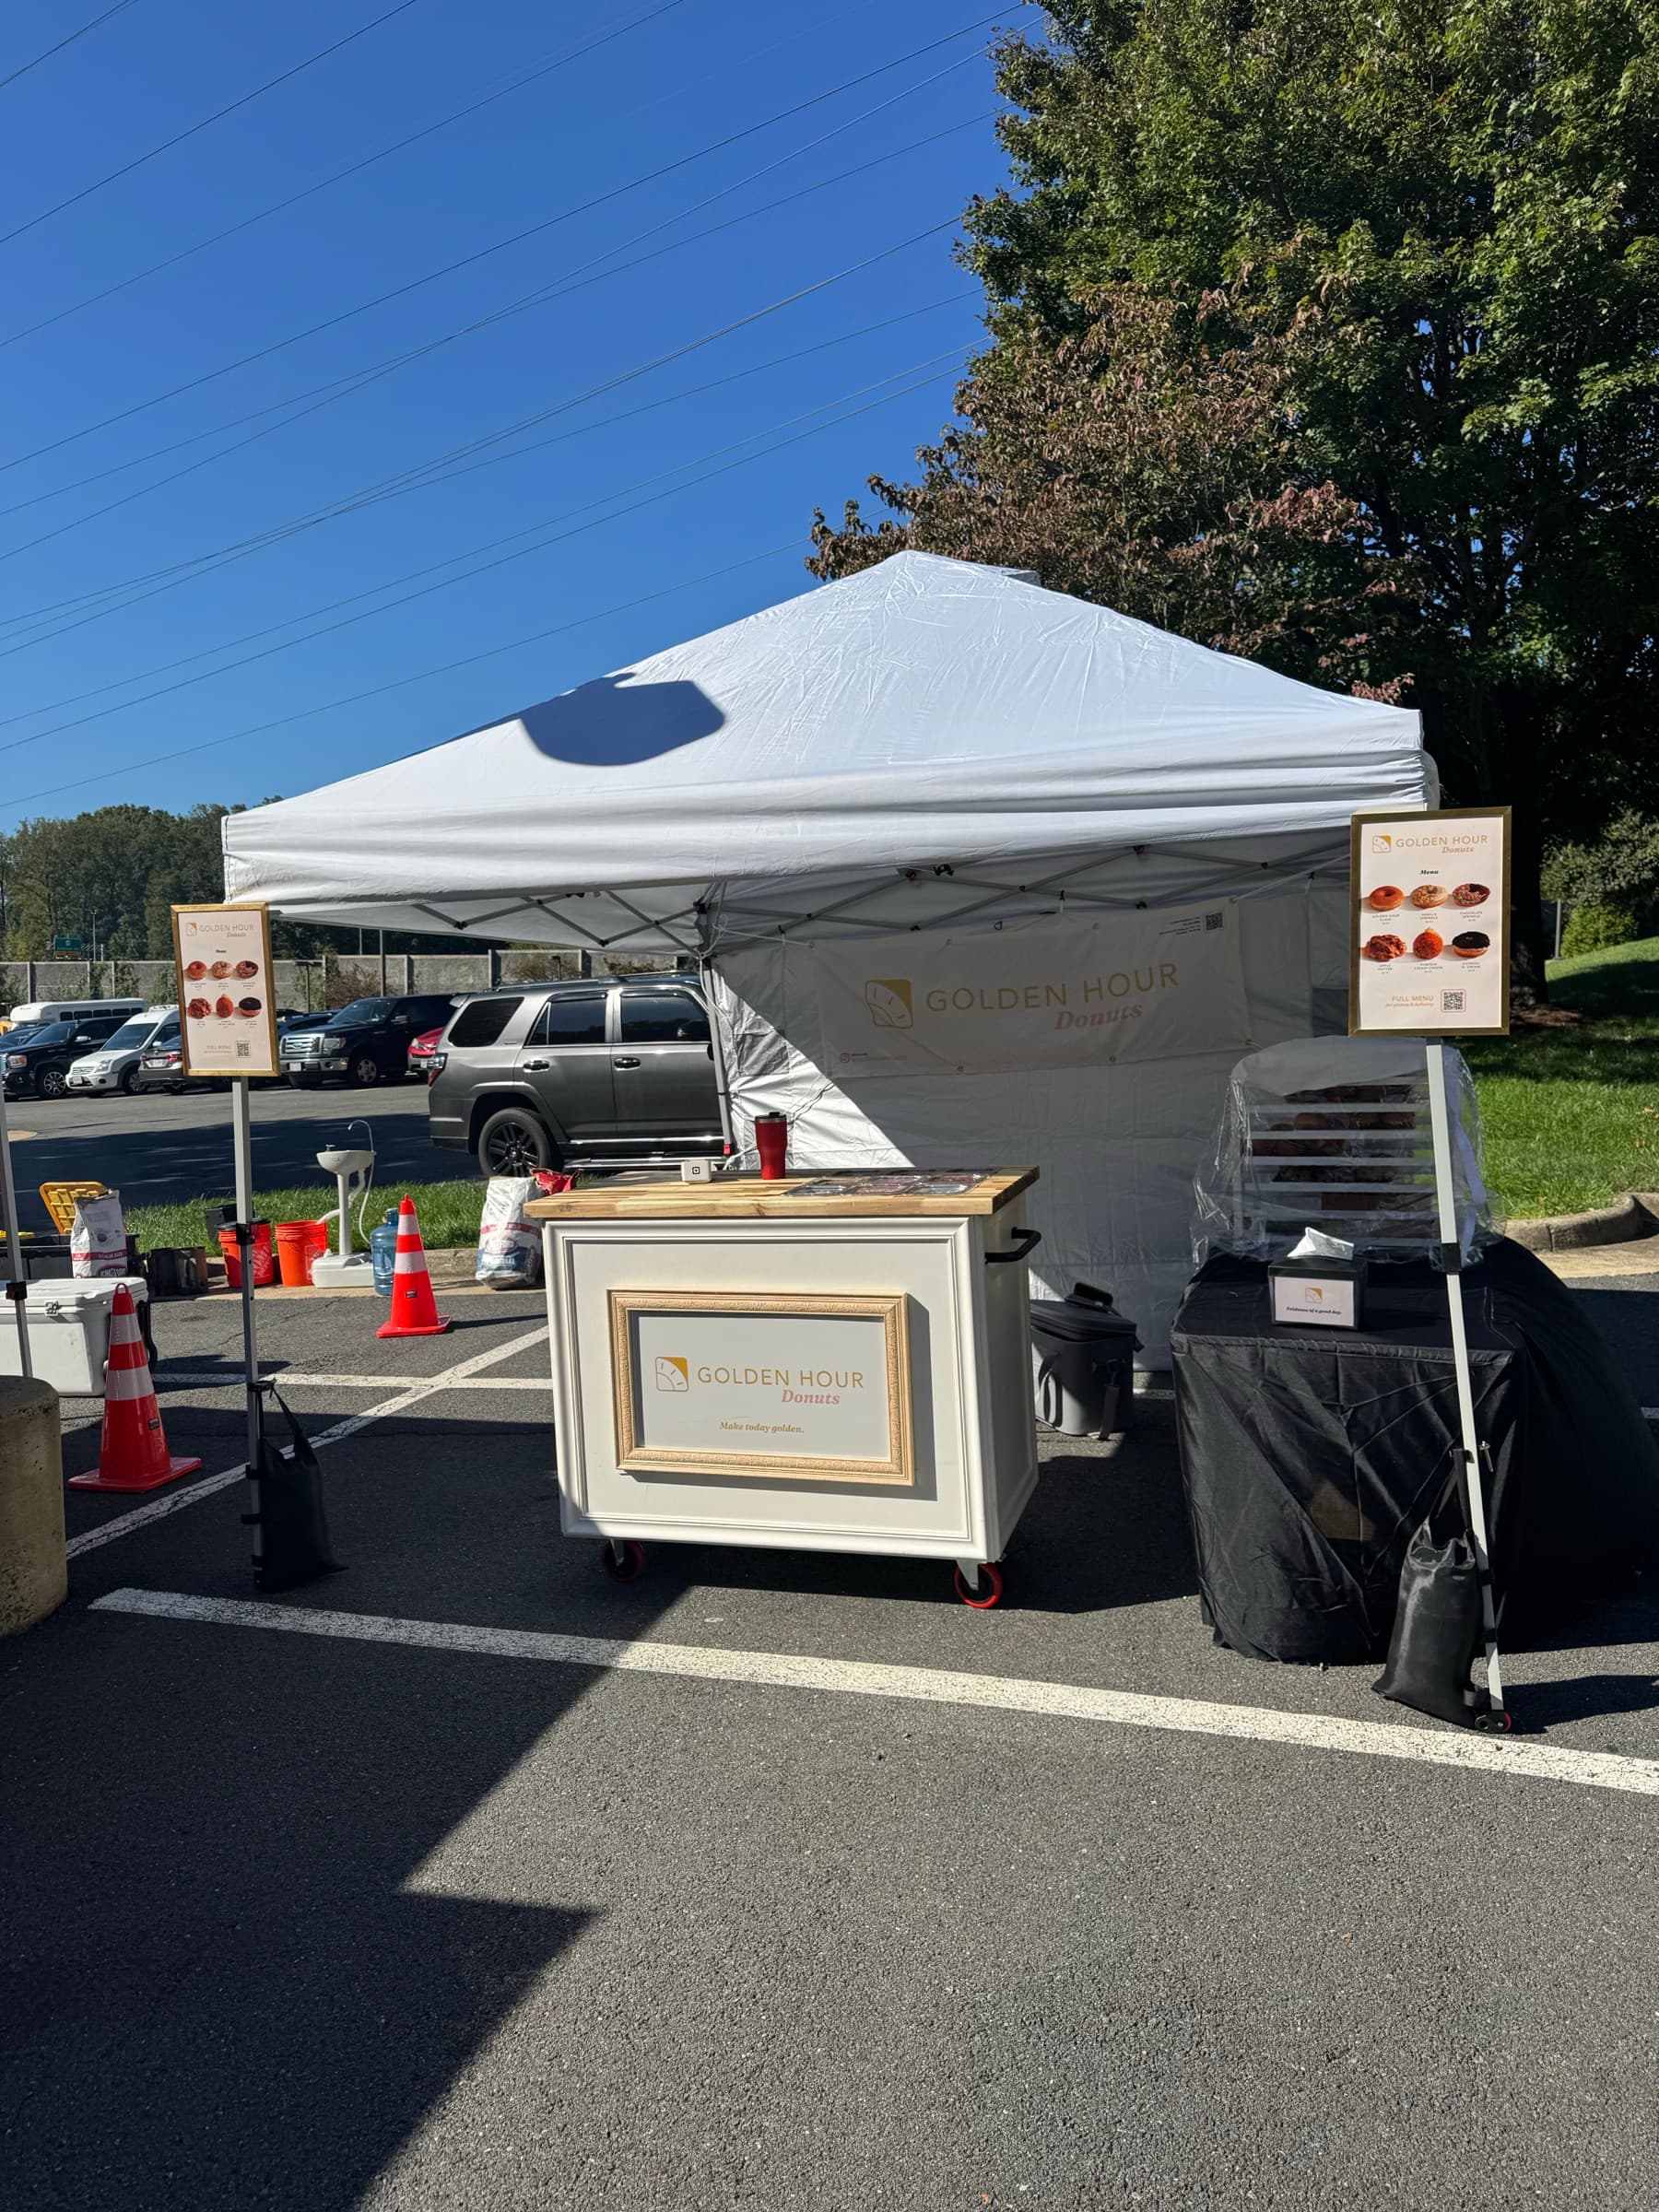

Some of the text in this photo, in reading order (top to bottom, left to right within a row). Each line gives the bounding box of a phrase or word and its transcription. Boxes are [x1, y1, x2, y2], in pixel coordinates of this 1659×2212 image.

[1395, 834, 1488, 848] GOLDEN HOUR
[199, 923, 254, 932] GOLDEN HOUR
[925, 962, 1180, 1012] GOLDEN HOUR
[1053, 1002, 1144, 1030] Donuts
[697, 1366, 865, 1389] GOLDEN HOUR
[781, 1388, 841, 1406] Donuts
[719, 1422, 805, 1434] Make today golden.
